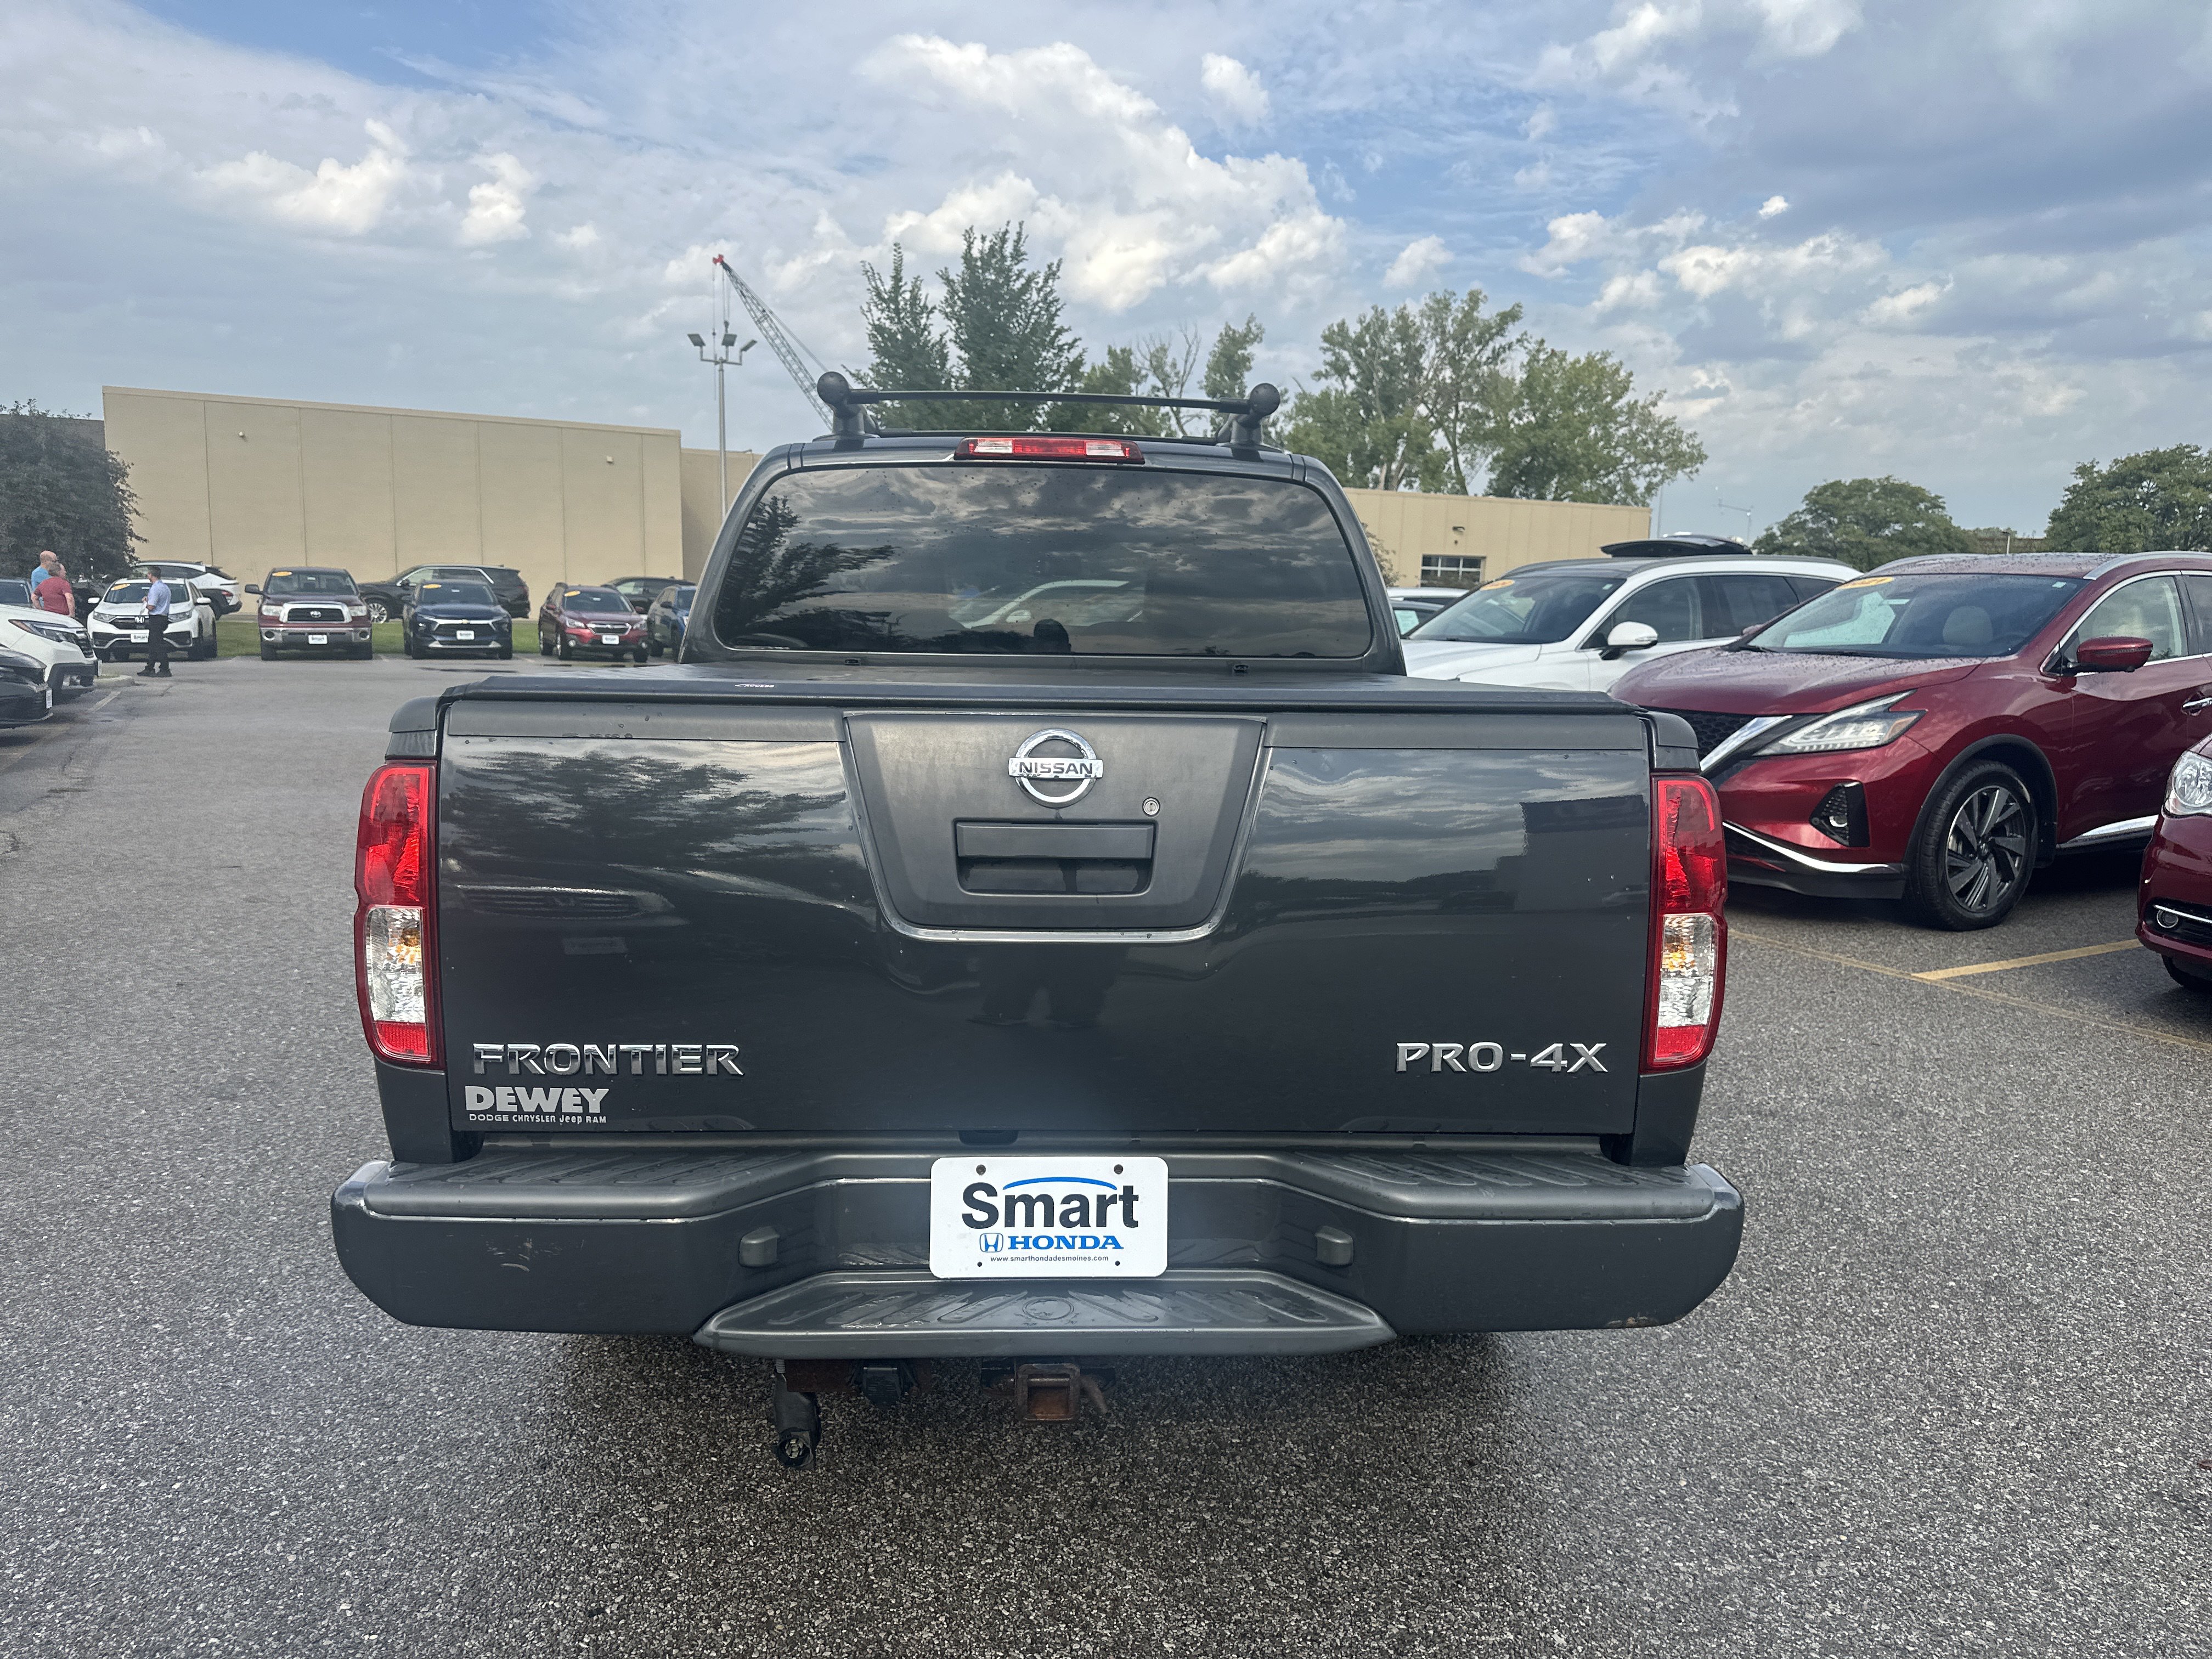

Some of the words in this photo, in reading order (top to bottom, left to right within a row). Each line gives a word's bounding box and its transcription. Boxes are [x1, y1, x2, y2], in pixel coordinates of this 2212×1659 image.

[1019, 761, 1093, 774] NISSAN
[473, 1043, 744, 1075] FRONTIER
[1396, 1042, 1609, 1073] PRO-4X
[465, 1086, 610, 1113] DEWEY
[512, 1114, 556, 1123] CHRYSLER
[559, 1115, 583, 1125] Jeep
[961, 1182, 1139, 1229] Smart
[1008, 1235, 1124, 1250] HONDA
